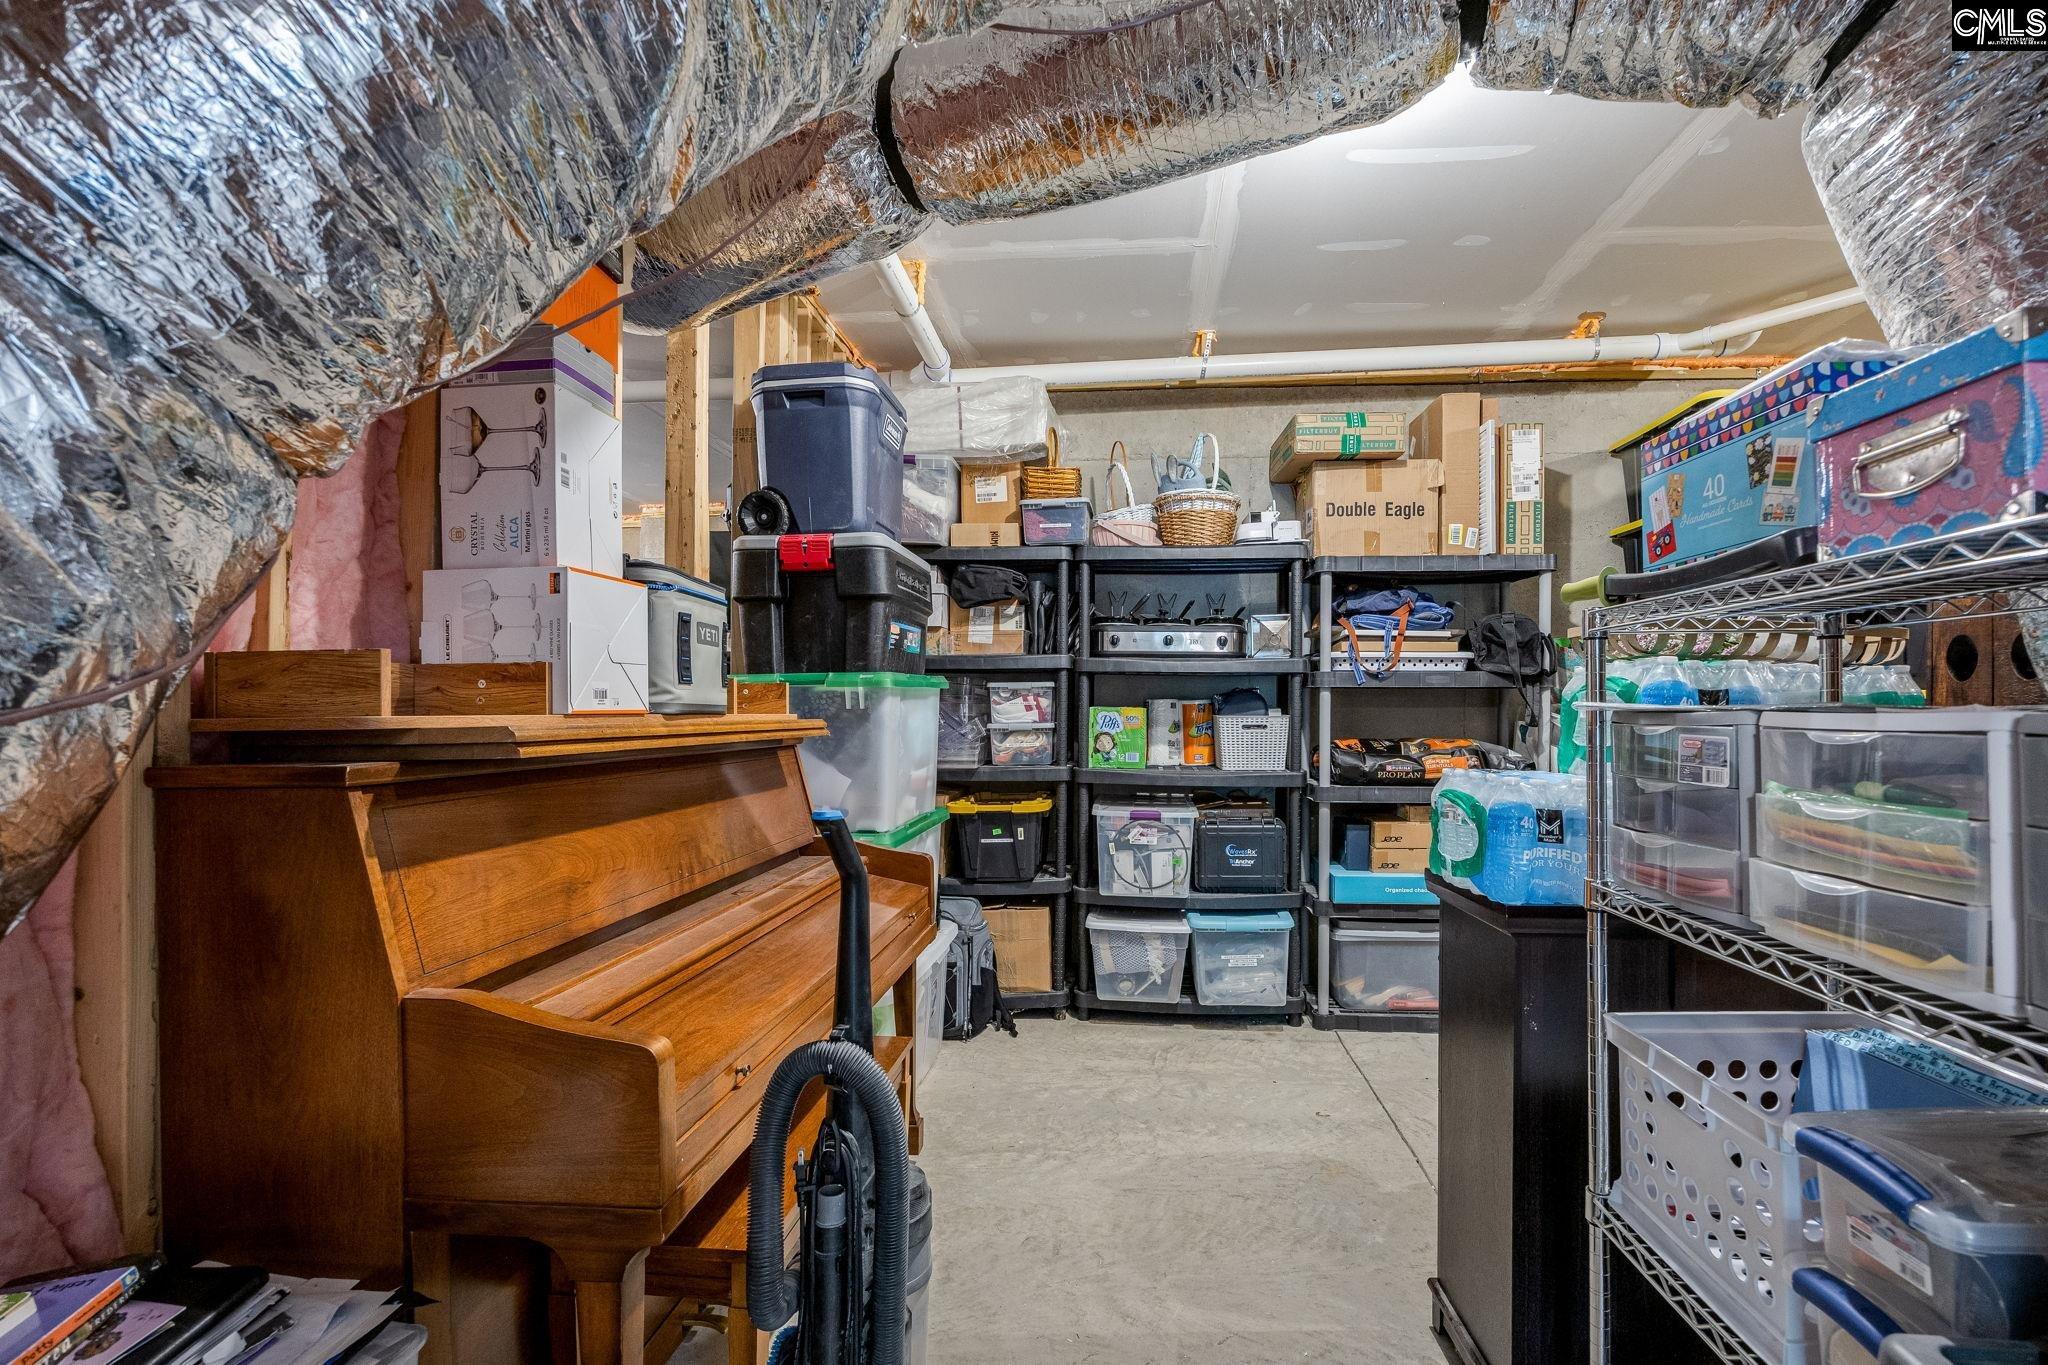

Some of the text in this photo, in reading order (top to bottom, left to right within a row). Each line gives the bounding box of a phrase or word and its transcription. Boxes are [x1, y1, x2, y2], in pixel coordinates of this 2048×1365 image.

[1703, 473, 1725, 499] 40
[524, 511, 532, 526] glass
[1326, 501, 1425, 520] Double Eagle
[1680, 505, 1725, 528] Handmade
[1727, 496, 1754, 513] Cards
[470, 511, 479, 556] CRYSTAL
[492, 514, 507, 552] Collection
[509, 516, 519, 548] ALCA
[699, 626, 718, 642] YETI
[445, 651, 450, 661] LE
[1100, 714, 1120, 730] Puffs
[1397, 771, 1421, 779] PLAN
[1520, 816, 1533, 829] 40
[1523, 847, 1582, 864] PURIFIED
[1548, 859, 1581, 875] YOUR
[1832, 1033, 1852, 1047] RED
[1897, 1045, 1925, 1062] Purple
[1914, 1061, 1948, 1080] Yellow
[1961, 1078, 1998, 1100] Green
